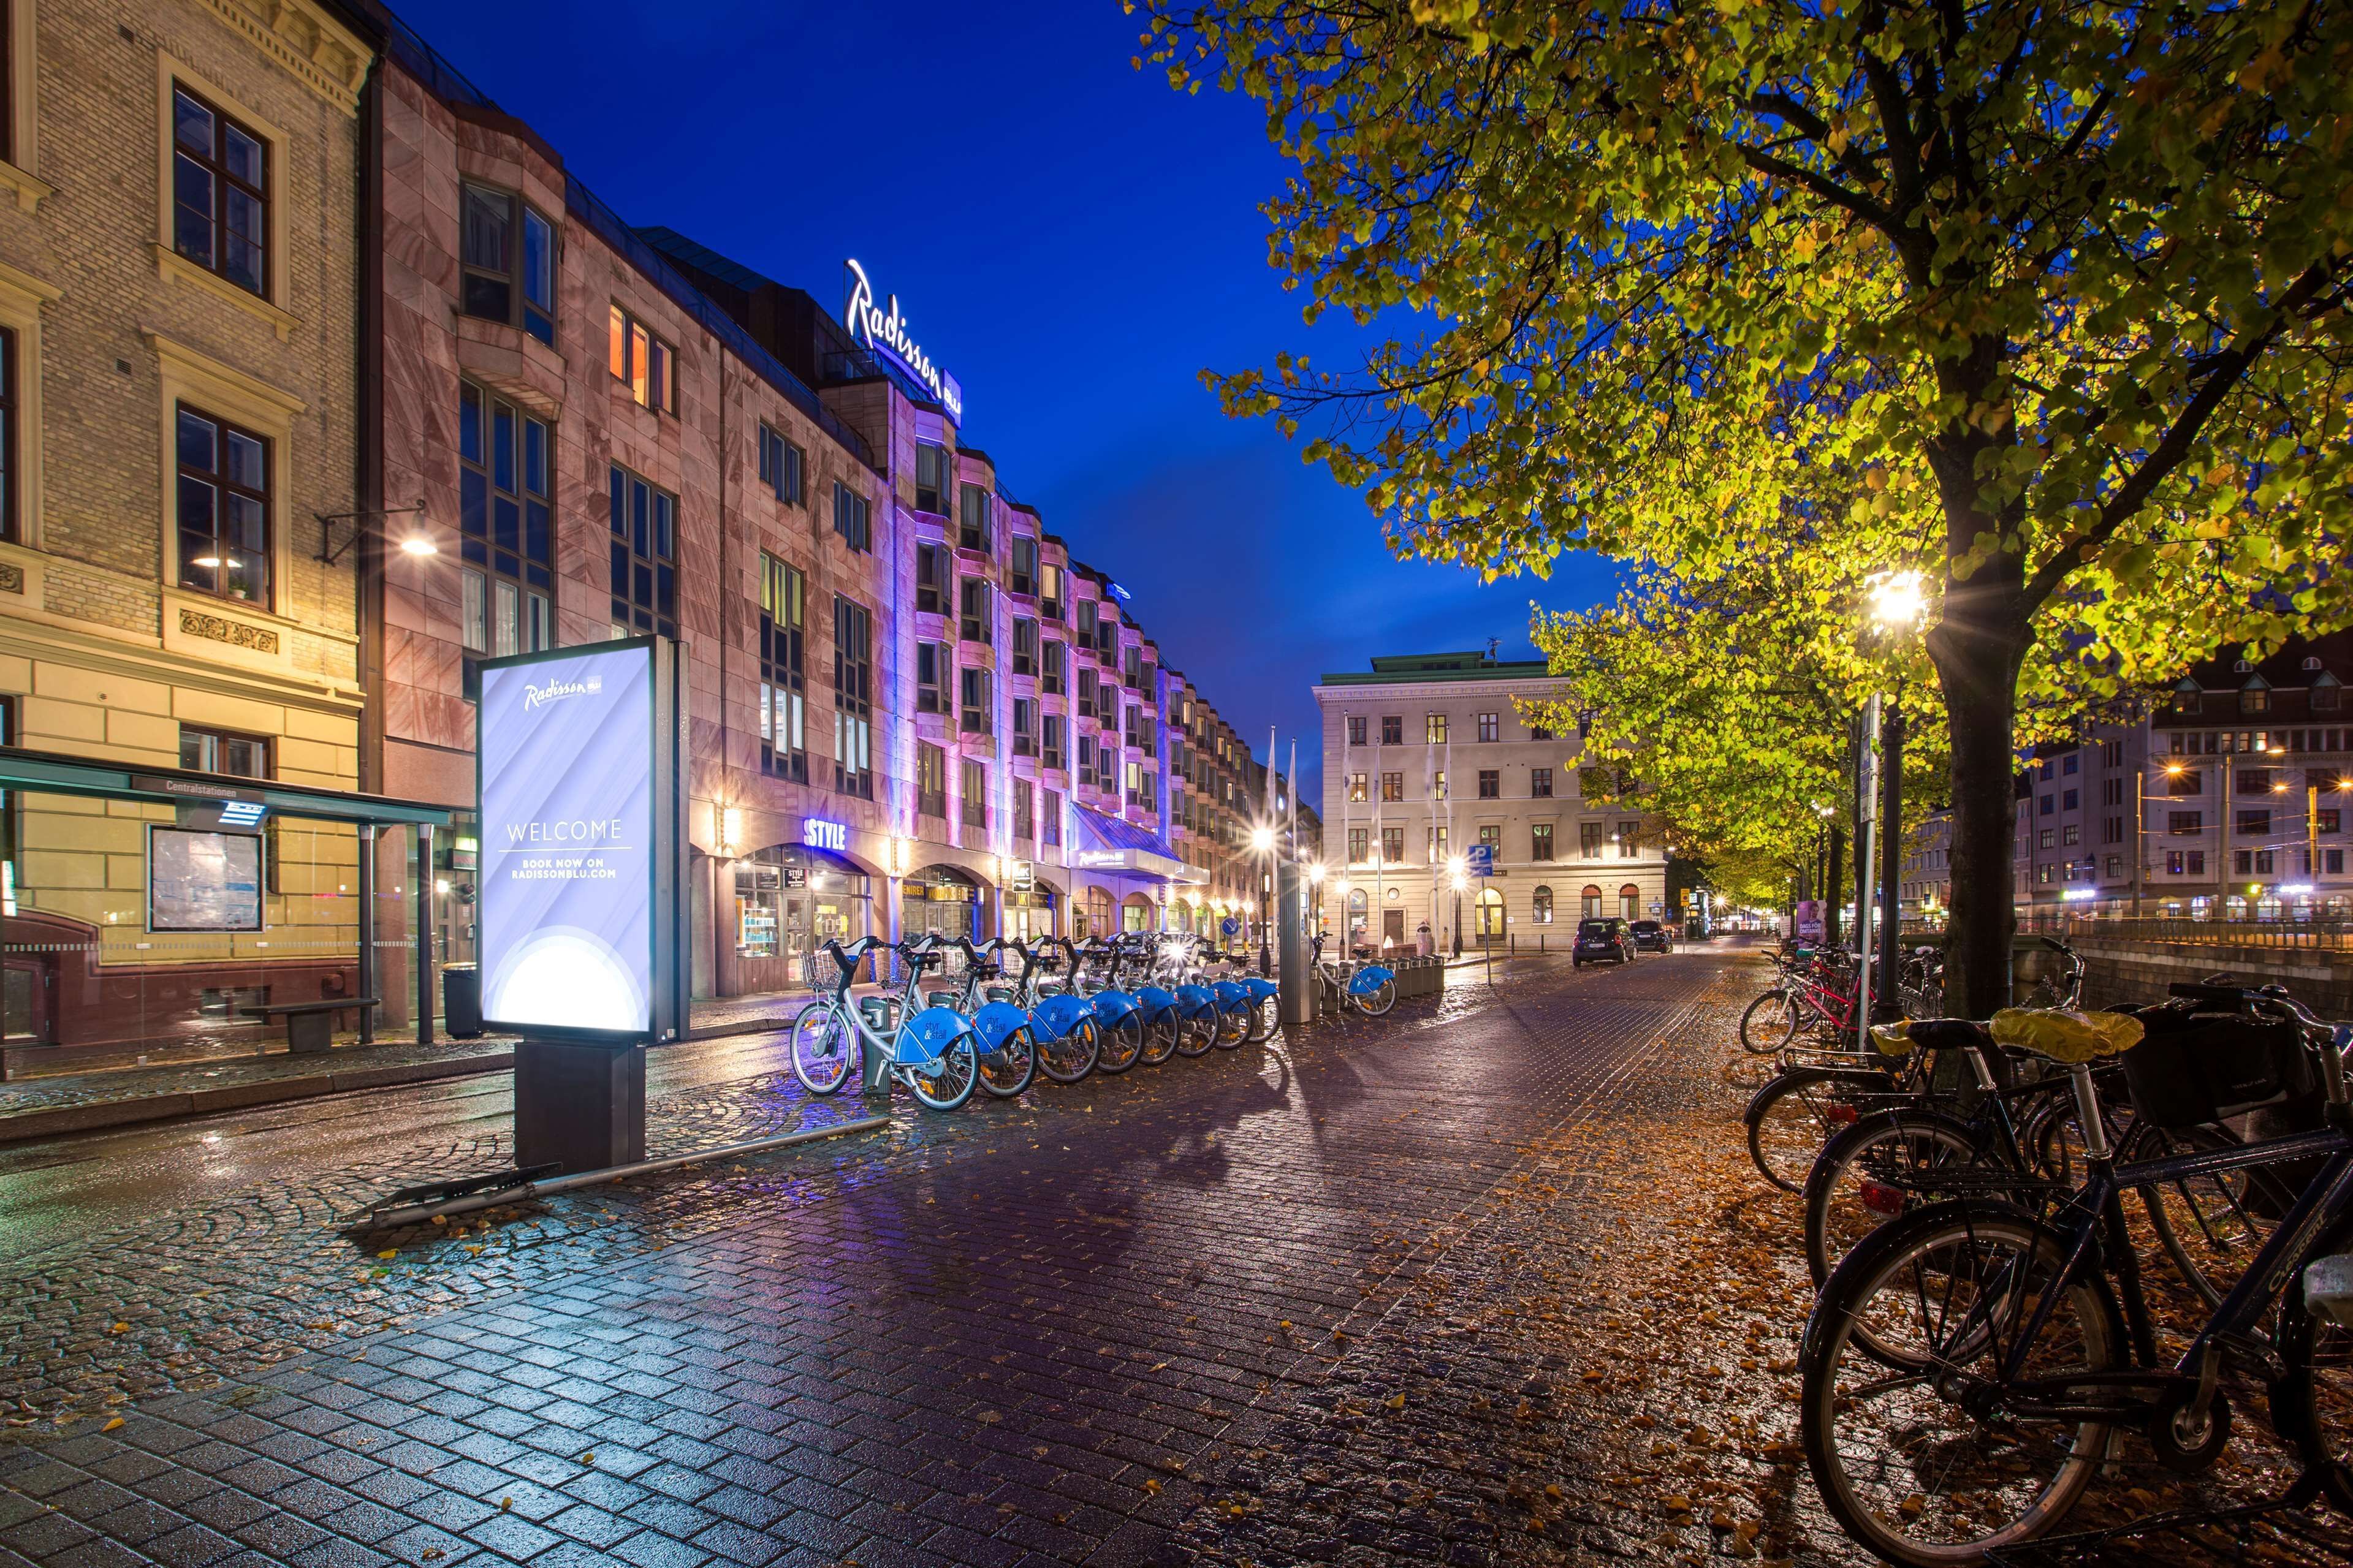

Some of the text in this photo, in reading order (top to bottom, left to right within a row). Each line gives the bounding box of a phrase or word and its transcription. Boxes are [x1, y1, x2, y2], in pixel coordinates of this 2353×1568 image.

[848, 259, 942, 399] Radisson
[524, 678, 586, 711] Radisson
[166, 780, 237, 797] Centralstationen
[507, 819, 621, 842] WELCOME
[804, 818, 846, 850] STYLE
[1475, 847, 1486, 863] P
[523, 858, 604, 869] BOOK NOW ON
[512, 869, 616, 879] RADISSONBLU.COM
[1018, 893, 1027, 906] MK
[925, 1021, 940, 1032] styr
[986, 1016, 1000, 1026] styr
